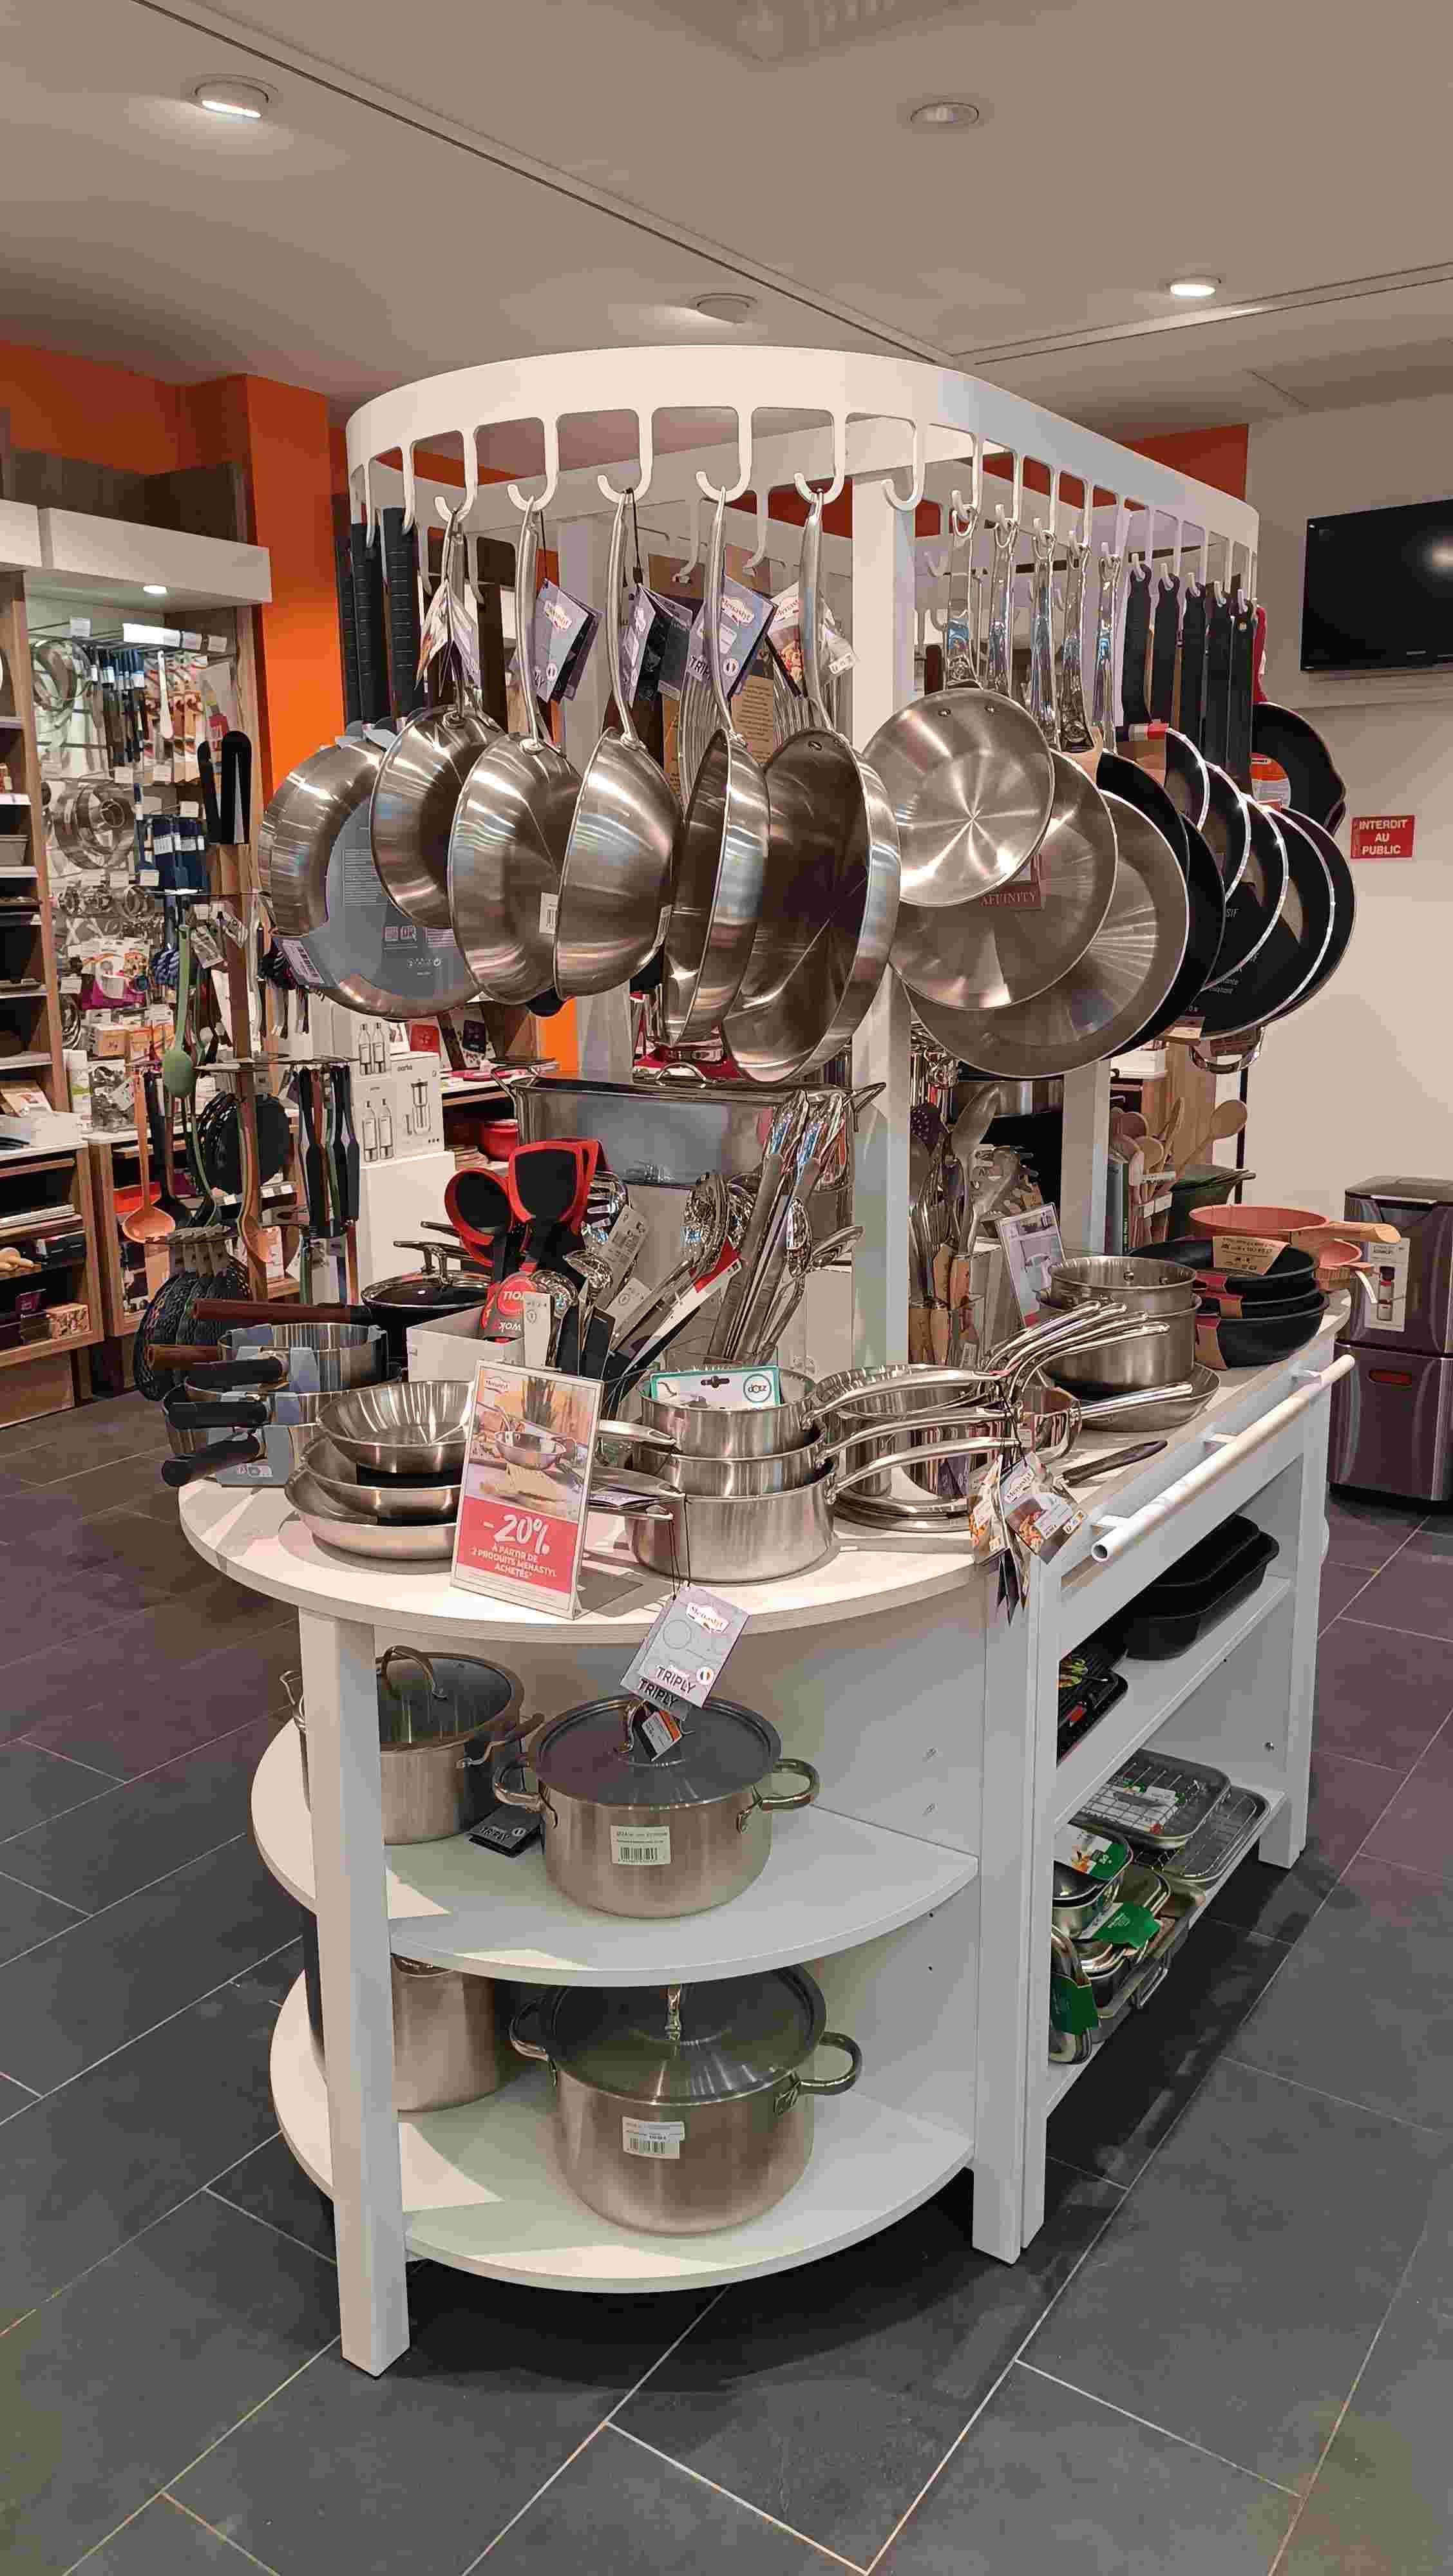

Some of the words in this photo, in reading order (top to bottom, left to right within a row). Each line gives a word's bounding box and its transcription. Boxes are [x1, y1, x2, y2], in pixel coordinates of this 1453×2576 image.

[1359, 819, 1407, 830] INTERDIT
[1375, 832, 1390, 842] AU
[1361, 844, 1401, 855] PUBLIC
[477, 1549, 516, 1566] PRODUITS
[499, 1546, 526, 1559] PARTIR
[527, 1553, 538, 1563] DE
[656, 1666, 696, 1694] TRIPLY
[638, 1678, 678, 1707] TRIPLY
